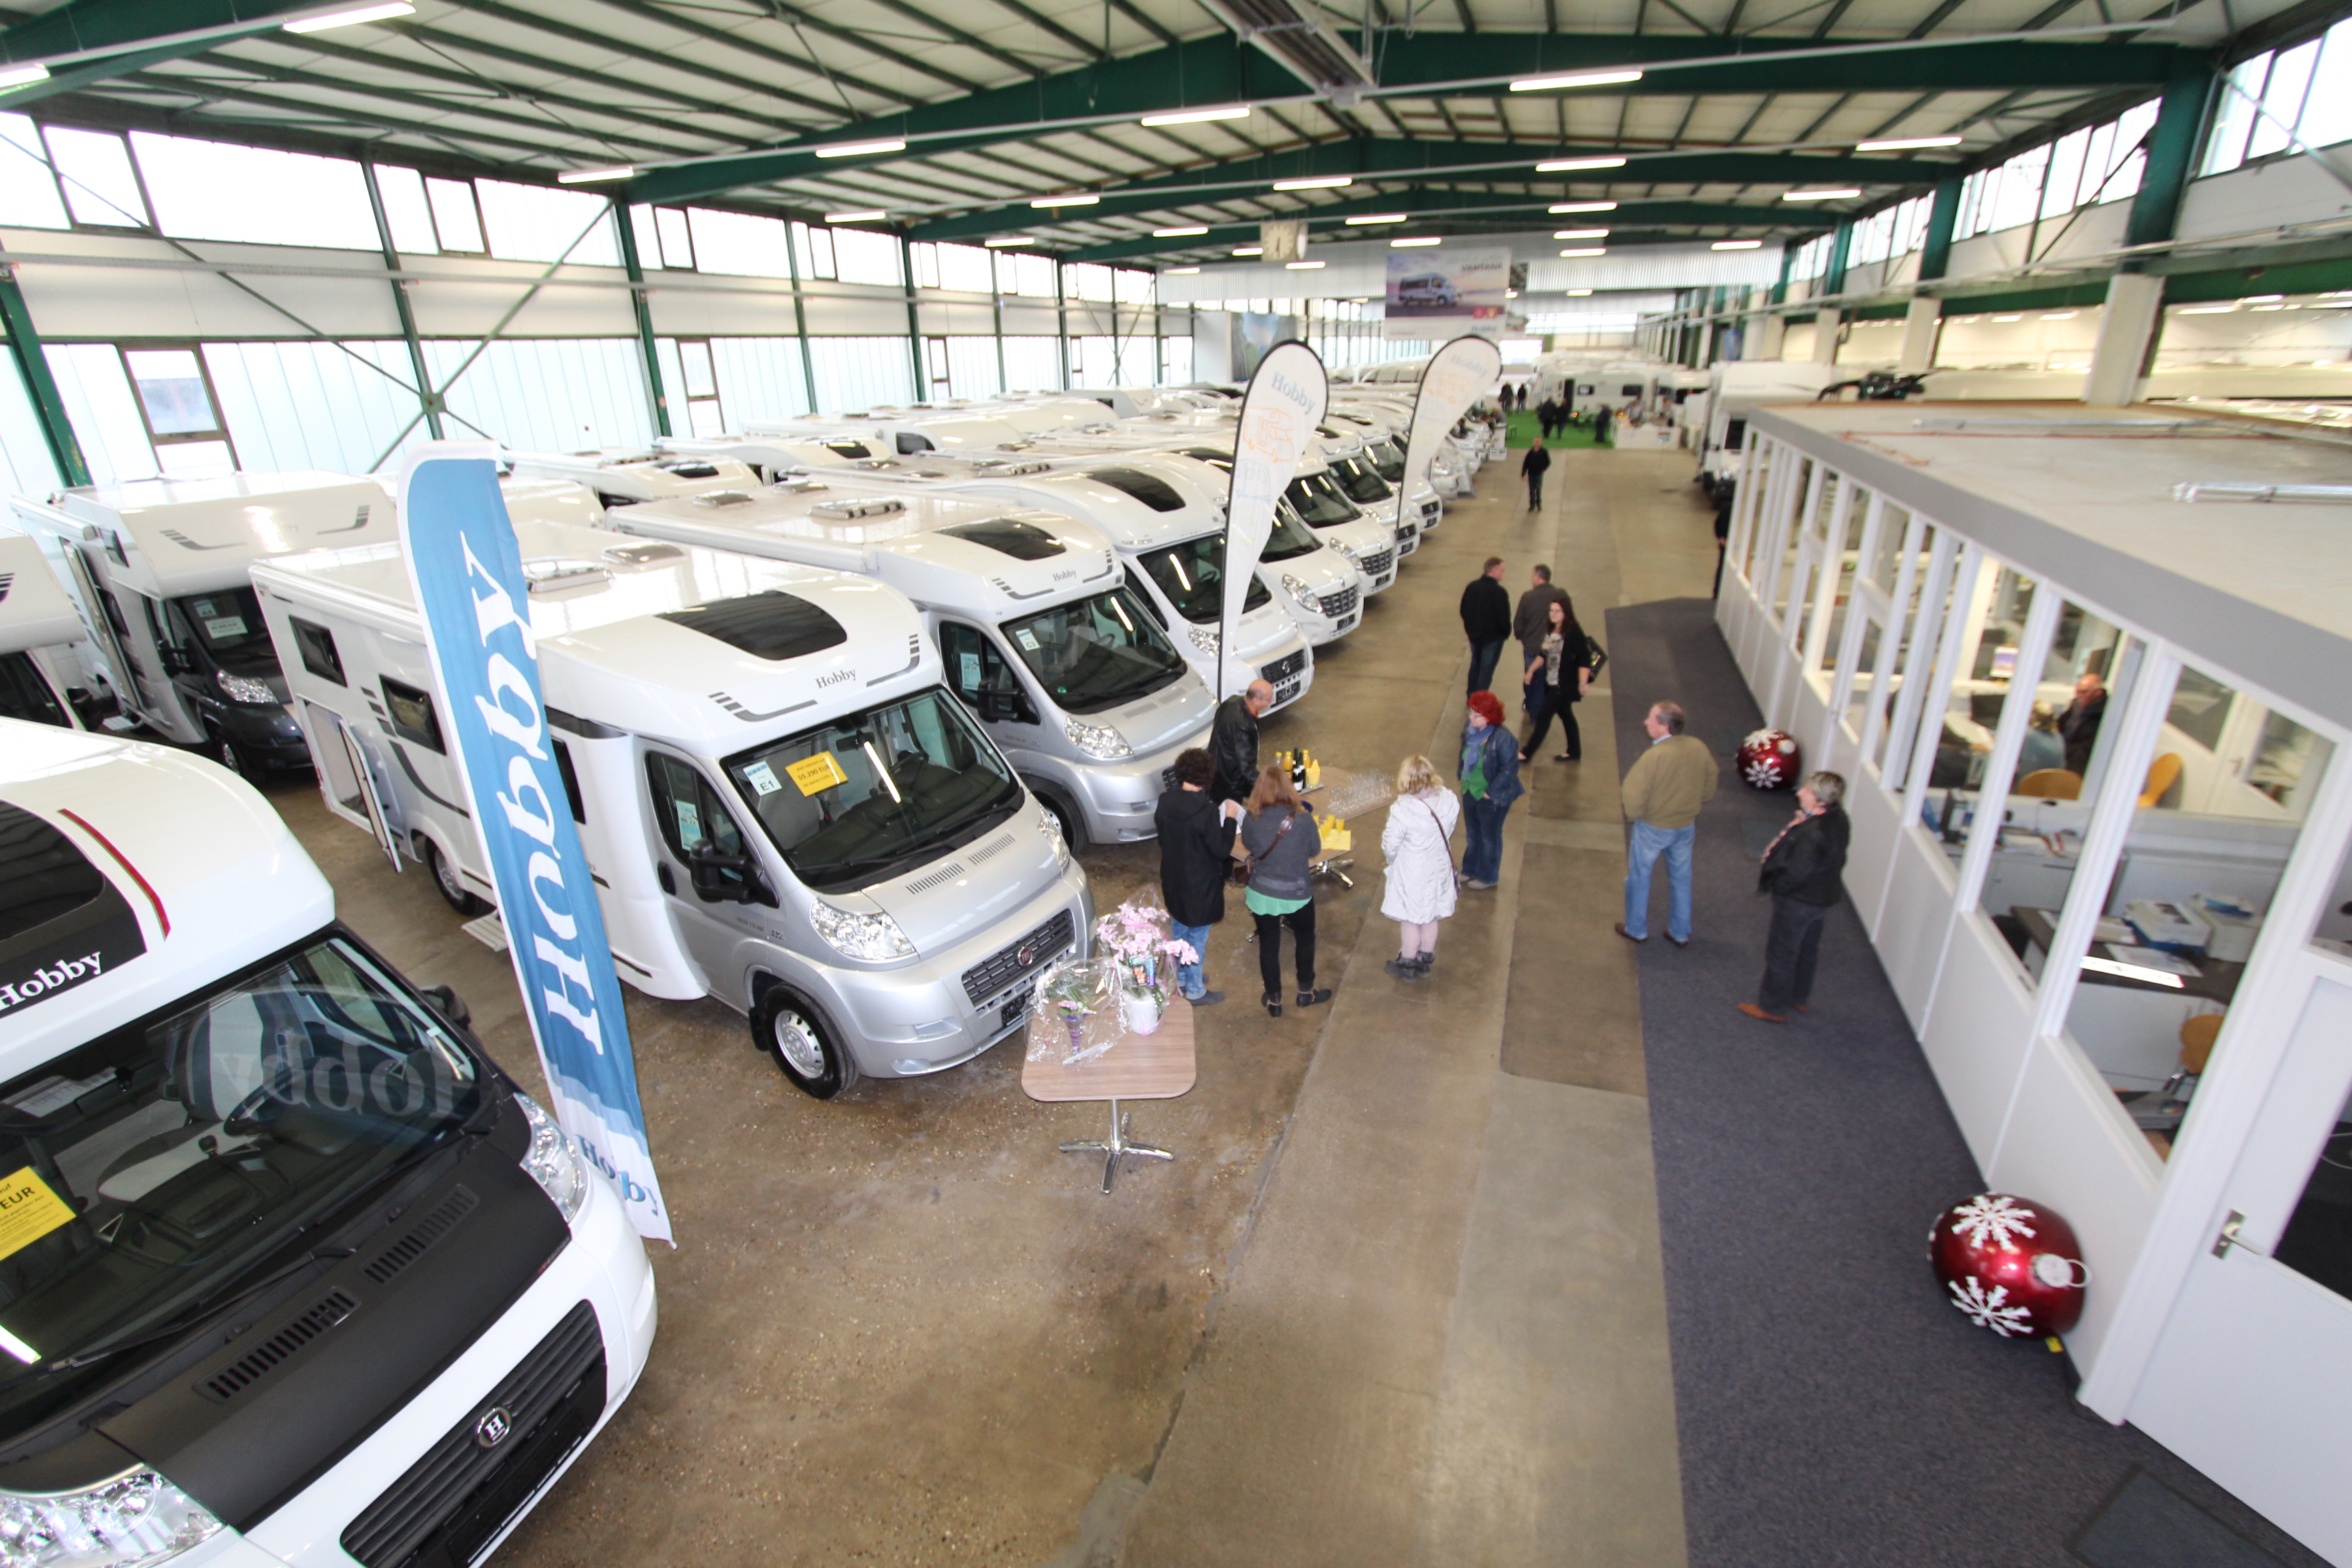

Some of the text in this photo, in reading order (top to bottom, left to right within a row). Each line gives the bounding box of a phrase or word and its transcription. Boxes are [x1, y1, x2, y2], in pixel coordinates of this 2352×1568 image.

[1450, 355, 1488, 376] Hobby
[1271, 372, 1316, 415] Hobby
[1052, 569, 1077, 582] Hobby
[815, 669, 856, 689] Hobby
[460, 530, 604, 1056] Hobby
[760, 780, 774, 791] E1
[0, 951, 101, 1011] Hobby
[0, 1187, 35, 1209] EUR
